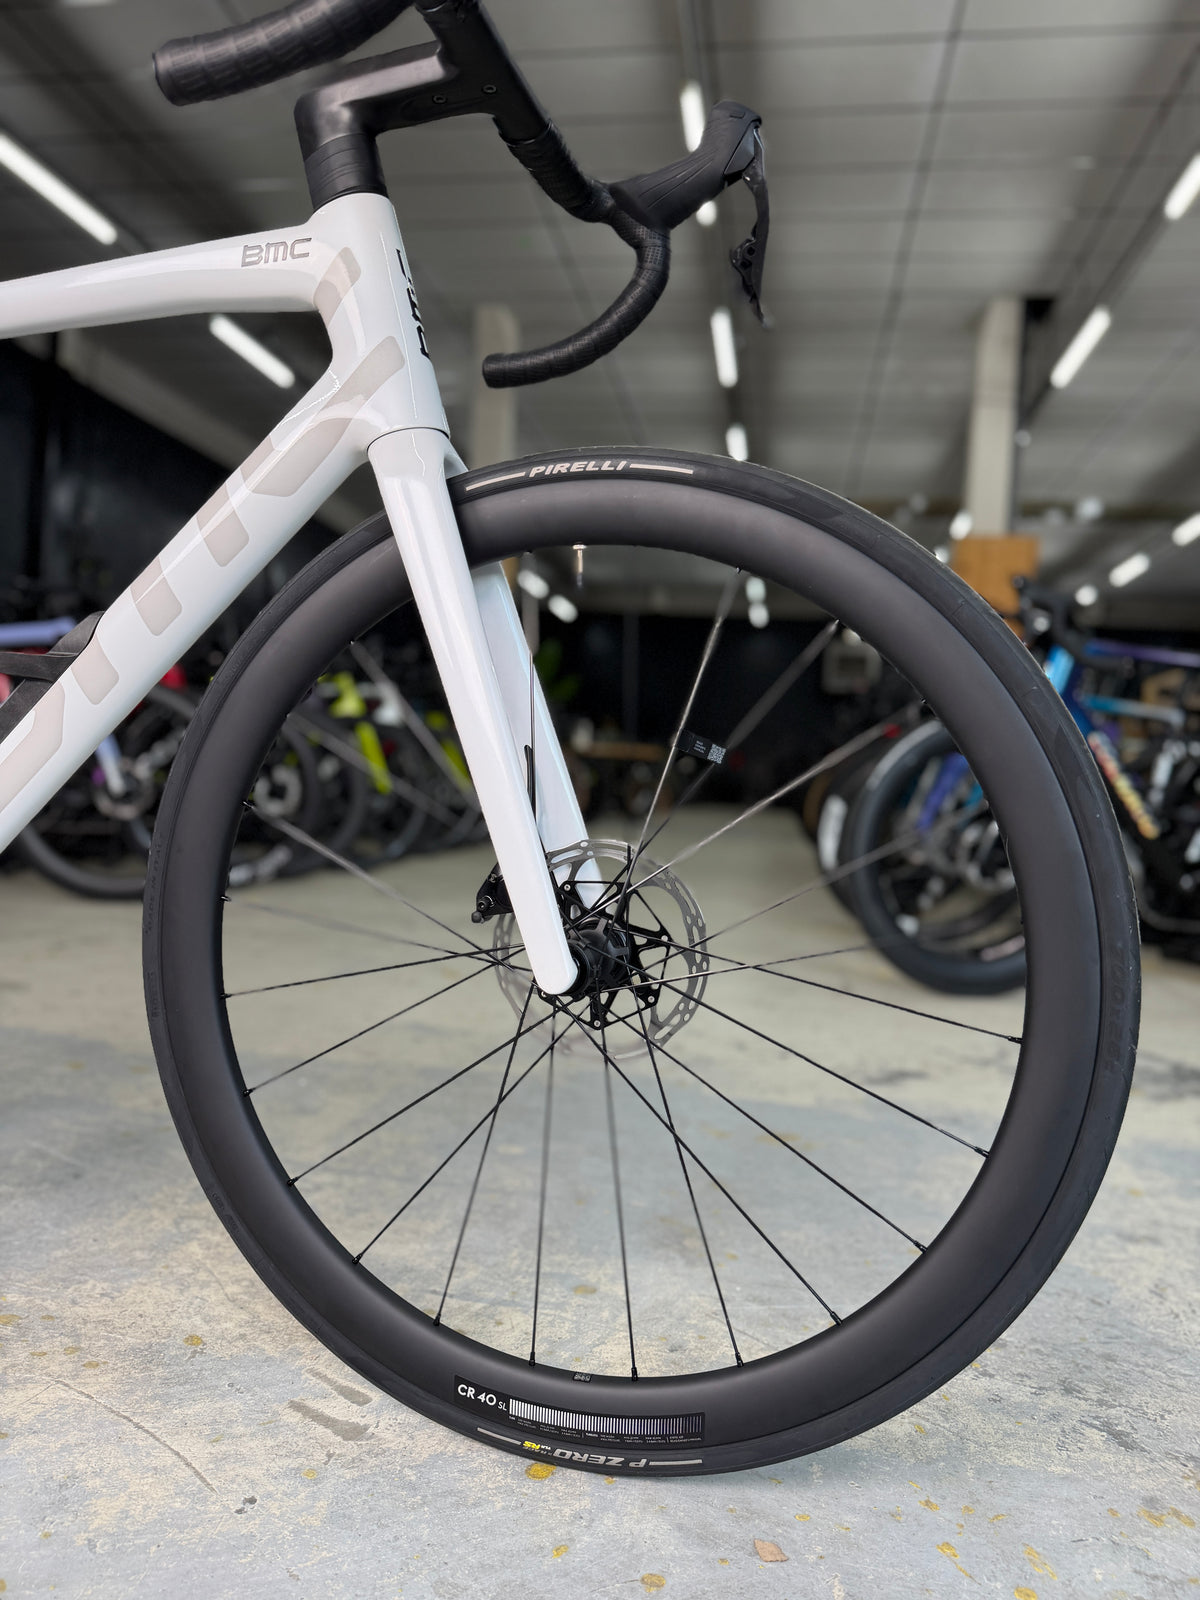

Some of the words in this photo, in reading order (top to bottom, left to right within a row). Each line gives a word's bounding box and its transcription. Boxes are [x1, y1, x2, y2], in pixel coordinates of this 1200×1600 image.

[241, 238, 312, 267] BMC
[529, 460, 627, 478] PIRELLI
[457, 1384, 476, 1400] CR
[477, 1391, 497, 1406] 40
[498, 1401, 507, 1411] SL
[553, 1449, 624, 1467] ZERO
[629, 1458, 648, 1468] P
